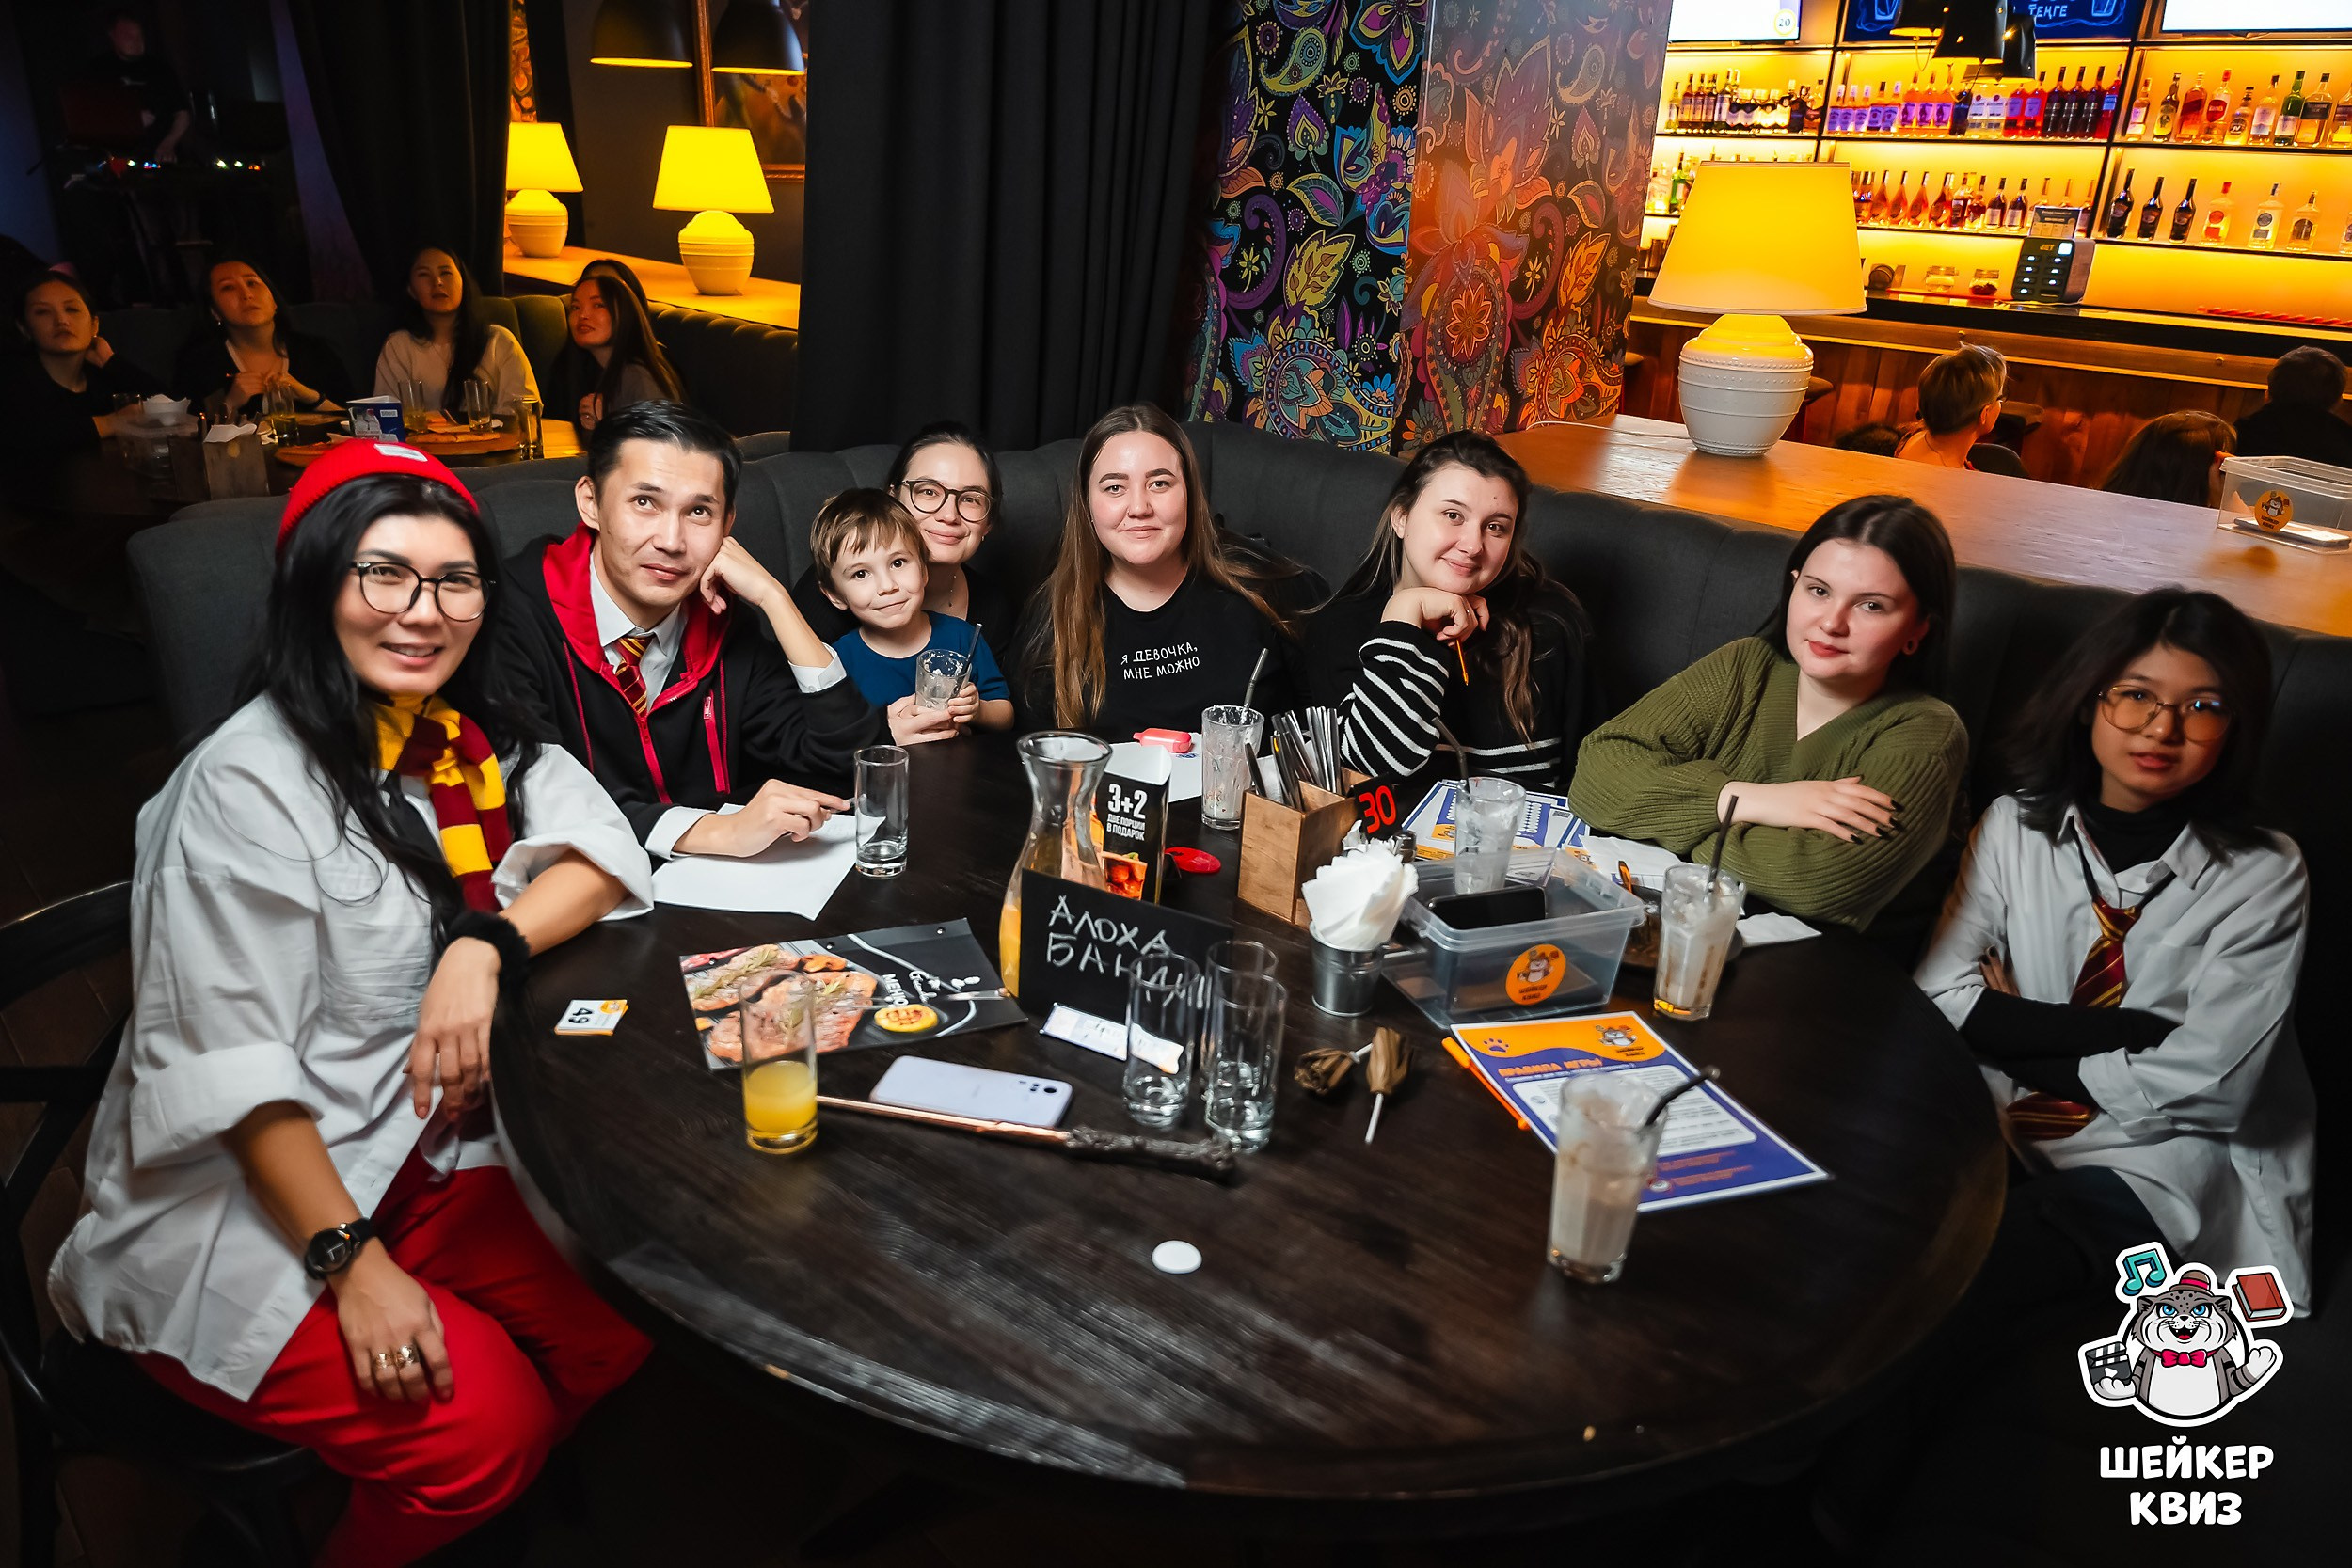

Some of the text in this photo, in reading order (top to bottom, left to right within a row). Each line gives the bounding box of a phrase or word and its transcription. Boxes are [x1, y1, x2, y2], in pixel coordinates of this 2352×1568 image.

[1120, 641, 1198, 665] Я ДЕВОЧКА,
[1123, 656, 1200, 680] МНЕ МОЖНО
[1107, 783, 1148, 819] 3+2
[1358, 785, 1397, 834] 30
[1106, 822, 1145, 841] В ПОДАРОК
[1048, 895, 1172, 956] АЛОХА
